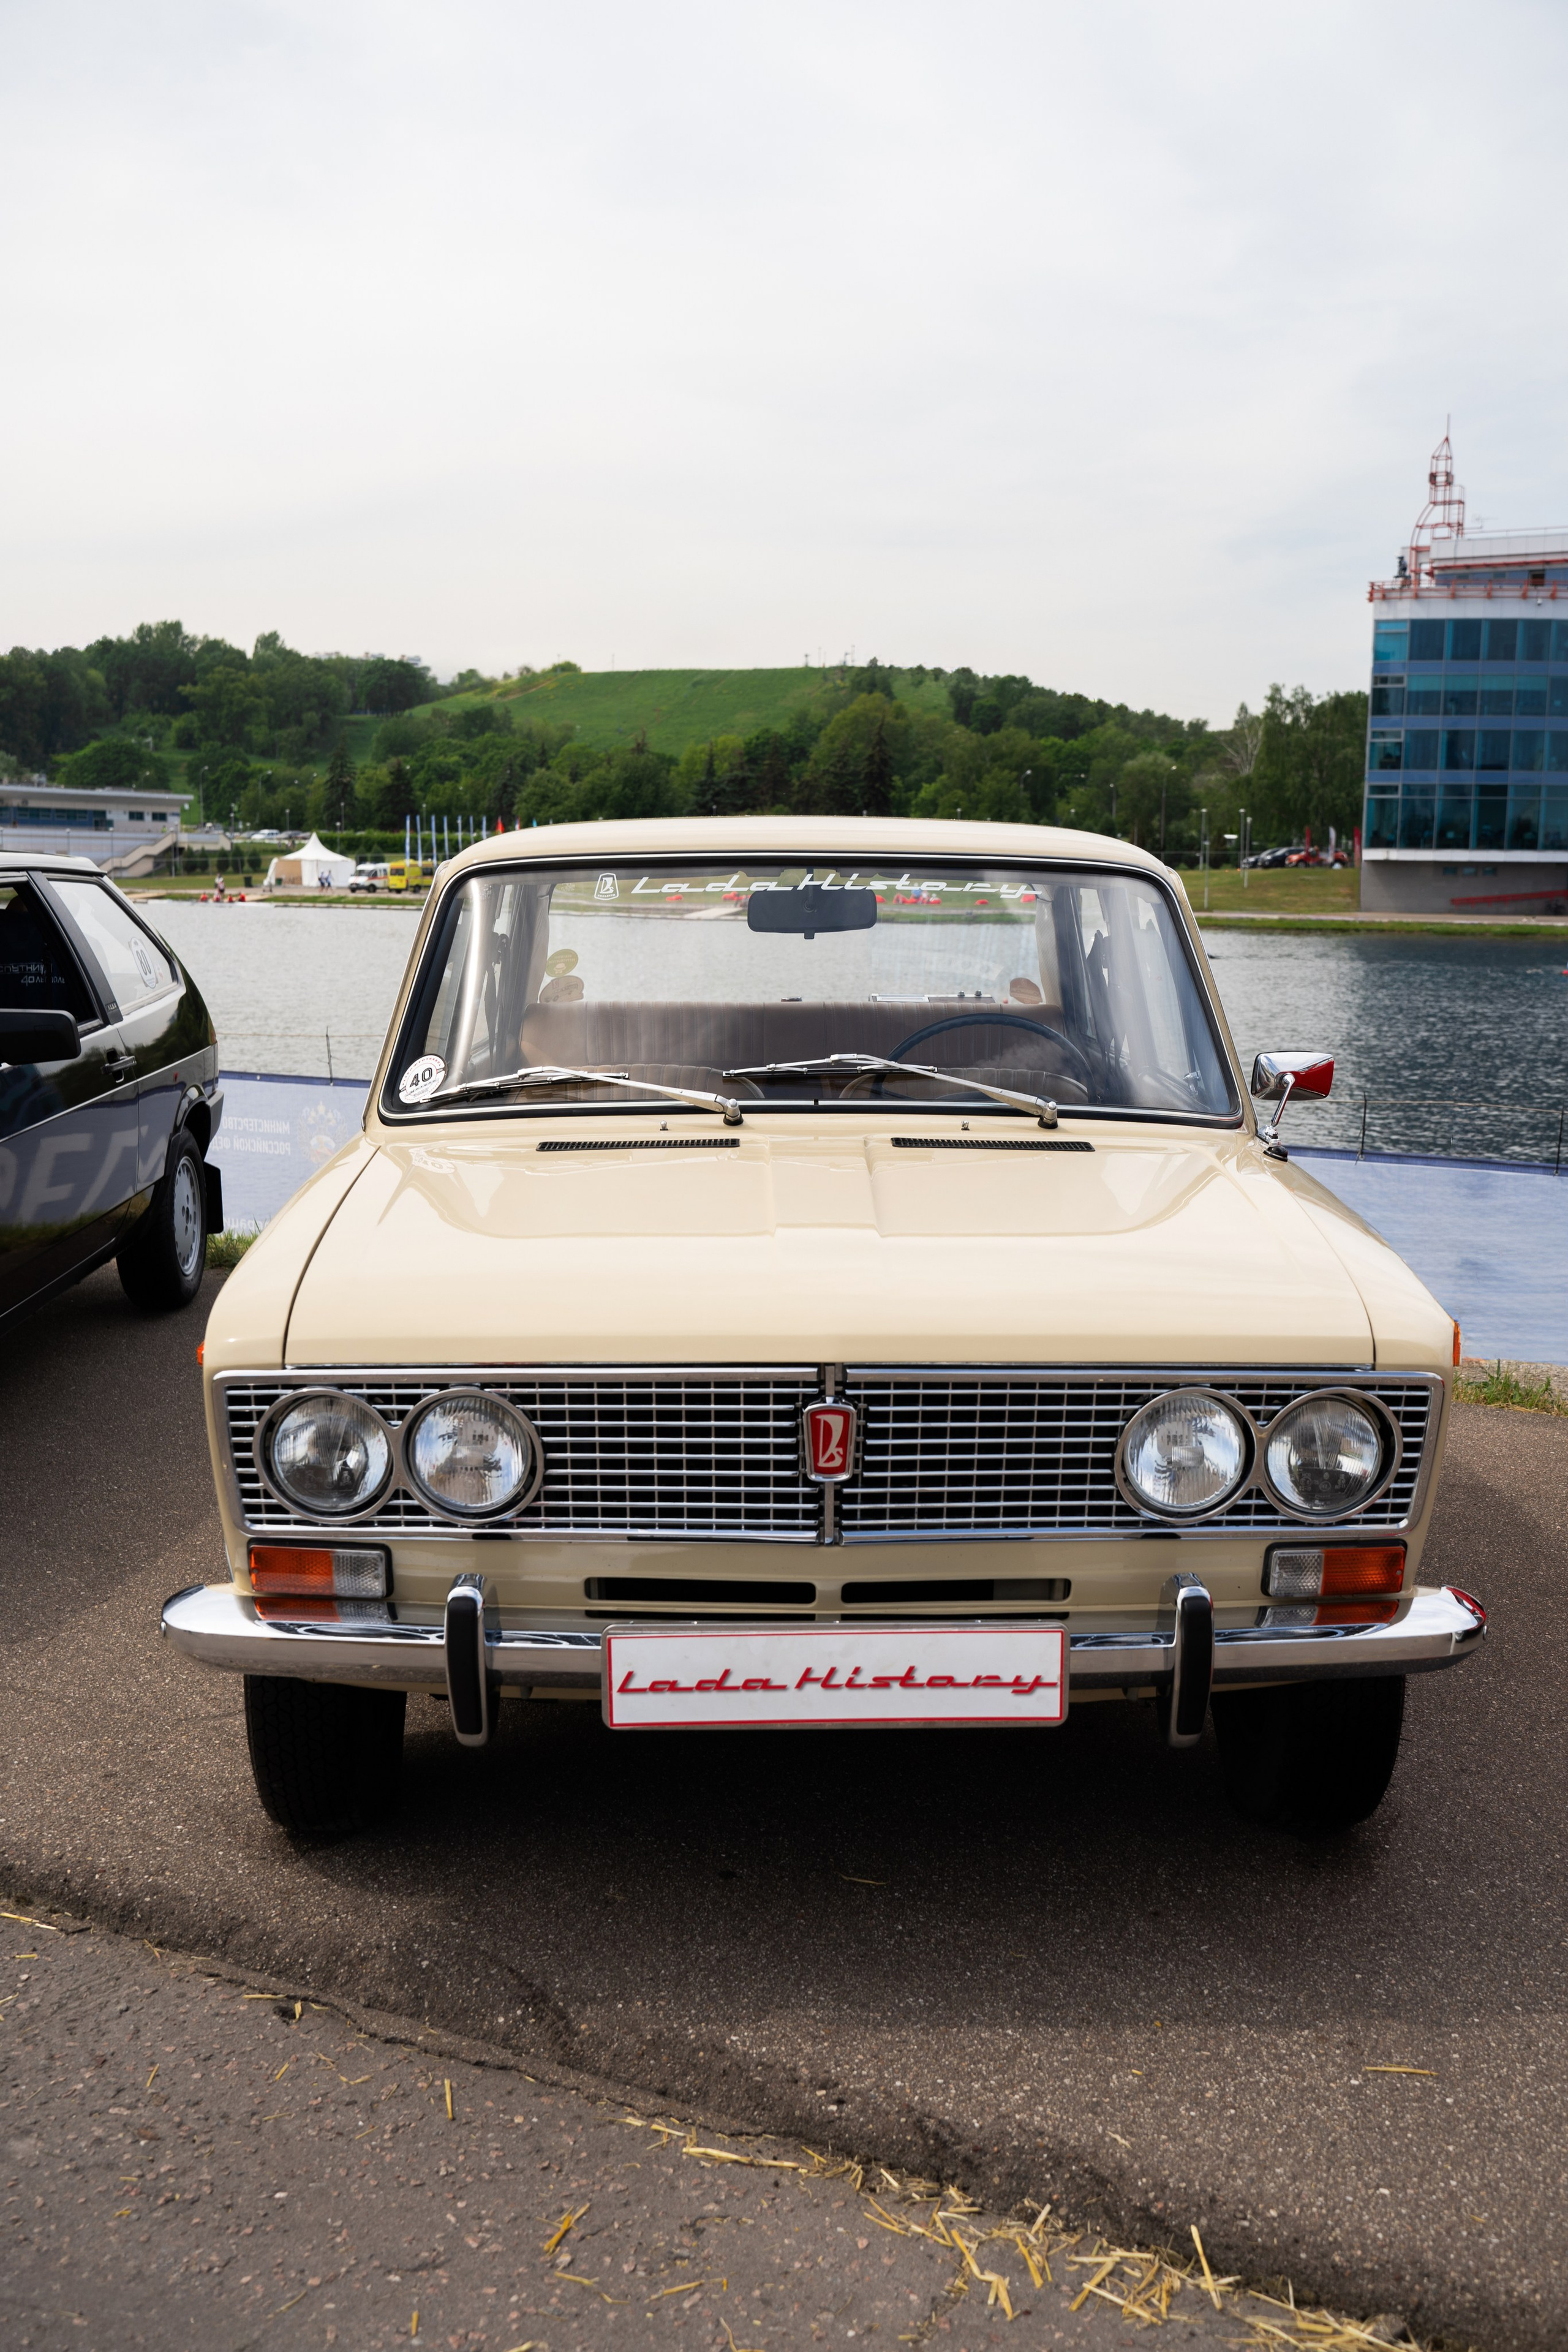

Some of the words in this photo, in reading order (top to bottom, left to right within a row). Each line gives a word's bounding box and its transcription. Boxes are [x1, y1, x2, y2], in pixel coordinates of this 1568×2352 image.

[631, 875, 793, 894] Lada
[797, 873, 1042, 899] History
[136, 949, 152, 976] 80
[410, 1068, 432, 1088] 40
[617, 1668, 789, 1694] Lada
[794, 1665, 1059, 1695] History
